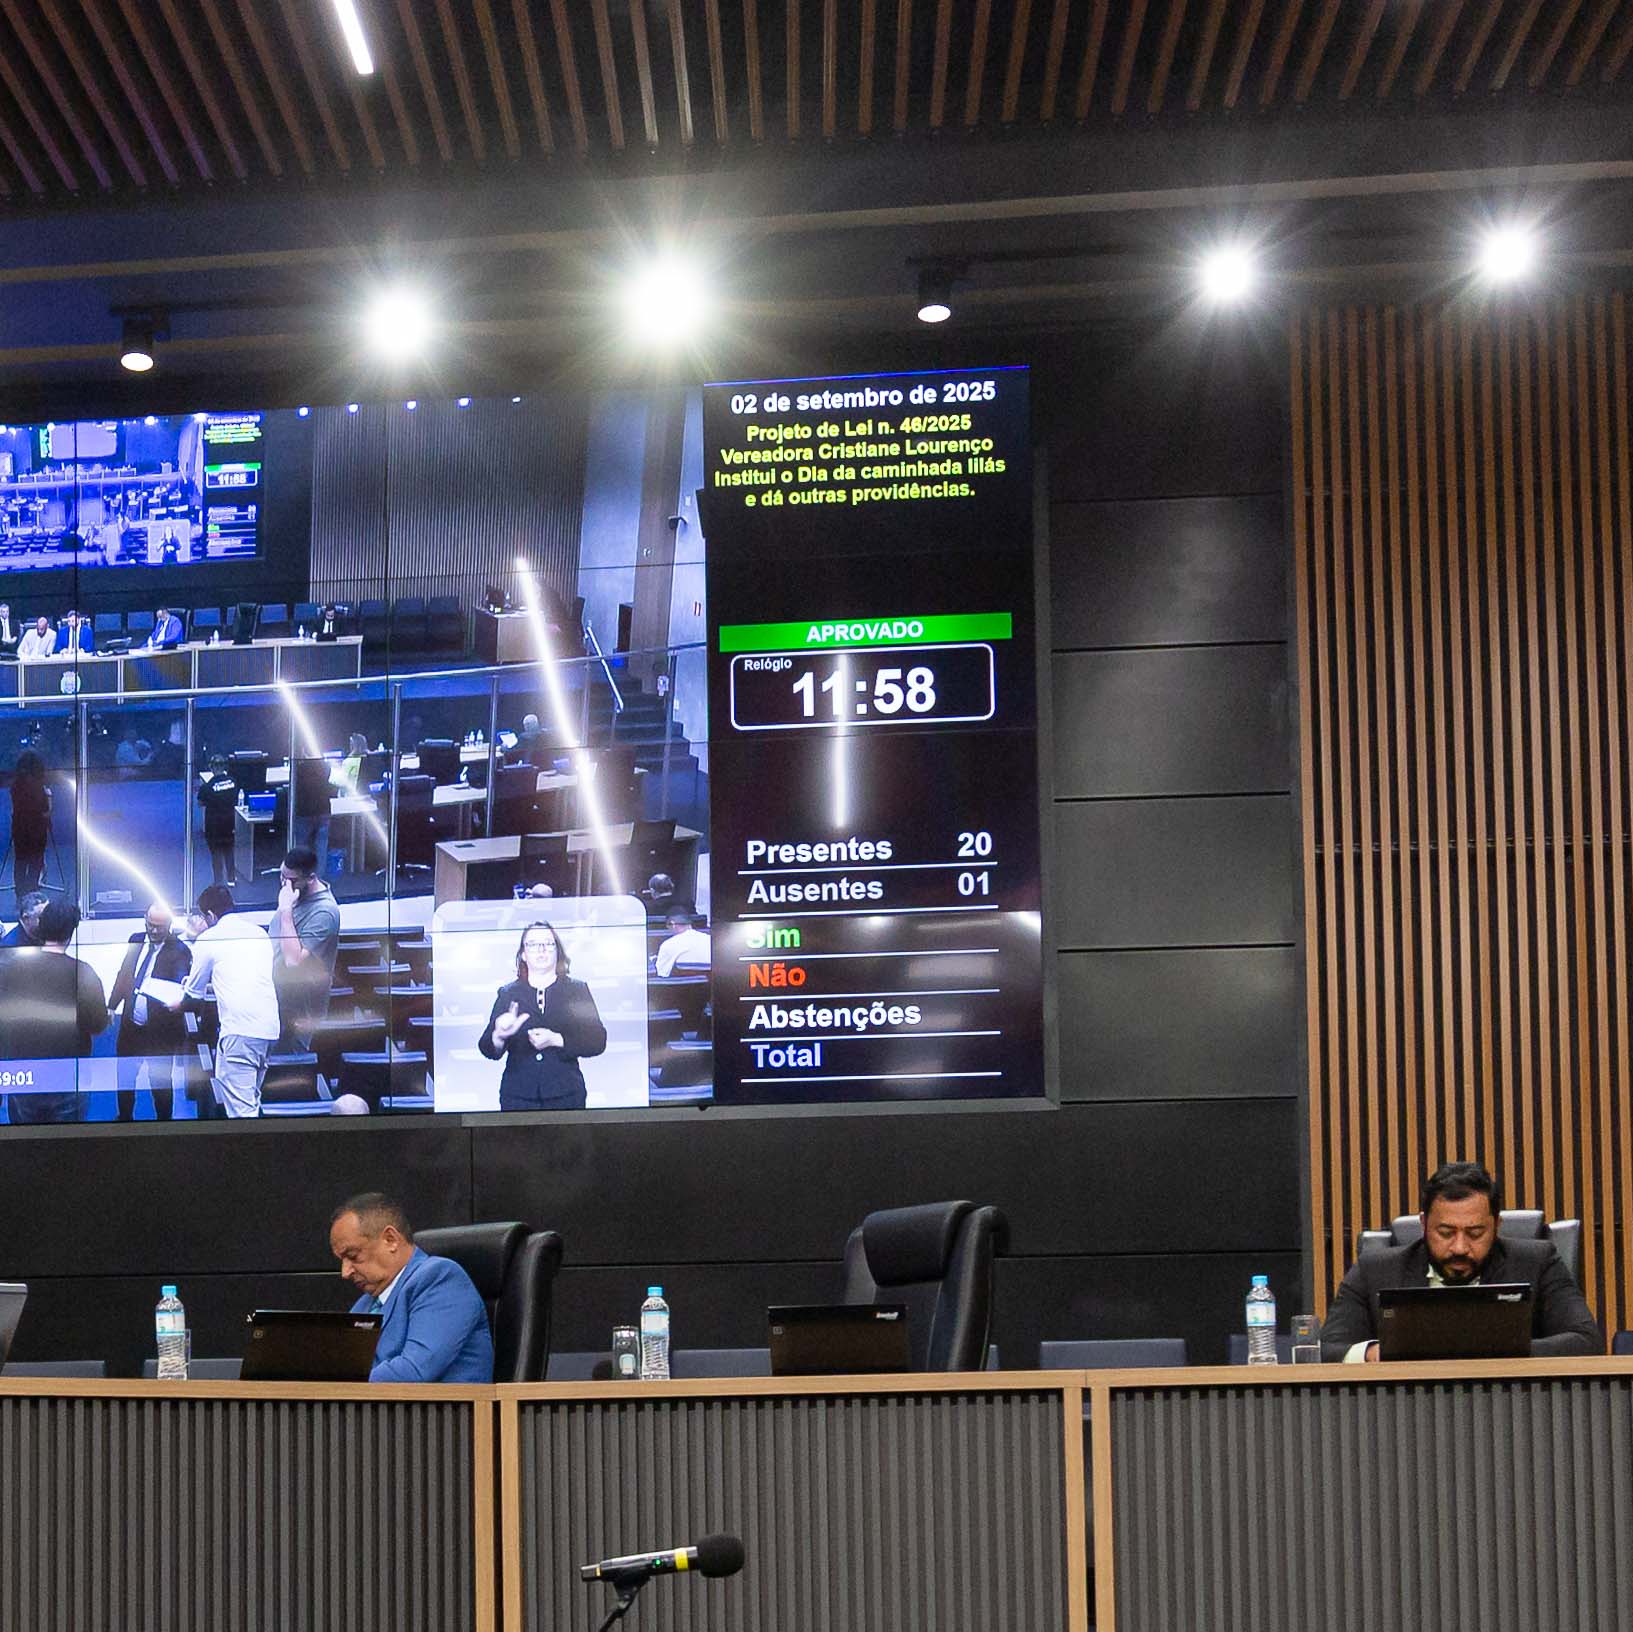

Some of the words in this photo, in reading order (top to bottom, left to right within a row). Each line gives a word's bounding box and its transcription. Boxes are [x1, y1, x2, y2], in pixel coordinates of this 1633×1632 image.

[731, 394, 757, 413] 02
[764, 393, 790, 412] de
[797, 387, 903, 410] setembro
[910, 384, 937, 404] de
[944, 381, 995, 402] 2025
[747, 423, 812, 443] Projeto
[817, 422, 839, 437] de
[845, 420, 872, 436] Lei
[878, 422, 894, 435] n.
[900, 415, 971, 433] 46/2025
[721, 447, 813, 464] Vereadora
[819, 441, 900, 459] Cristiane
[906, 438, 993, 456] Lourenço
[715, 468, 775, 487] Institui
[781, 472, 792, 483] o
[798, 467, 827, 483] Dia
[833, 464, 855, 480] da
[861, 460, 962, 479] caminhada
[968, 458, 1005, 473] lilás
[746, 495, 756, 506] e
[761, 490, 783, 506] dá
[789, 489, 846, 504] outras
[853, 482, 975, 505] providências.
[806, 621, 923, 642] APROVADO
[745, 658, 792, 672] Relógio
[793, 667, 936, 717] 11:58
[747, 837, 892, 864] Presentes
[958, 832, 992, 857] 20
[748, 877, 883, 903] Ausentes
[959, 872, 990, 896] 01
[750, 963, 806, 988] Não
[749, 1002, 921, 1031] Abstenções
[750, 1043, 821, 1067] Total
